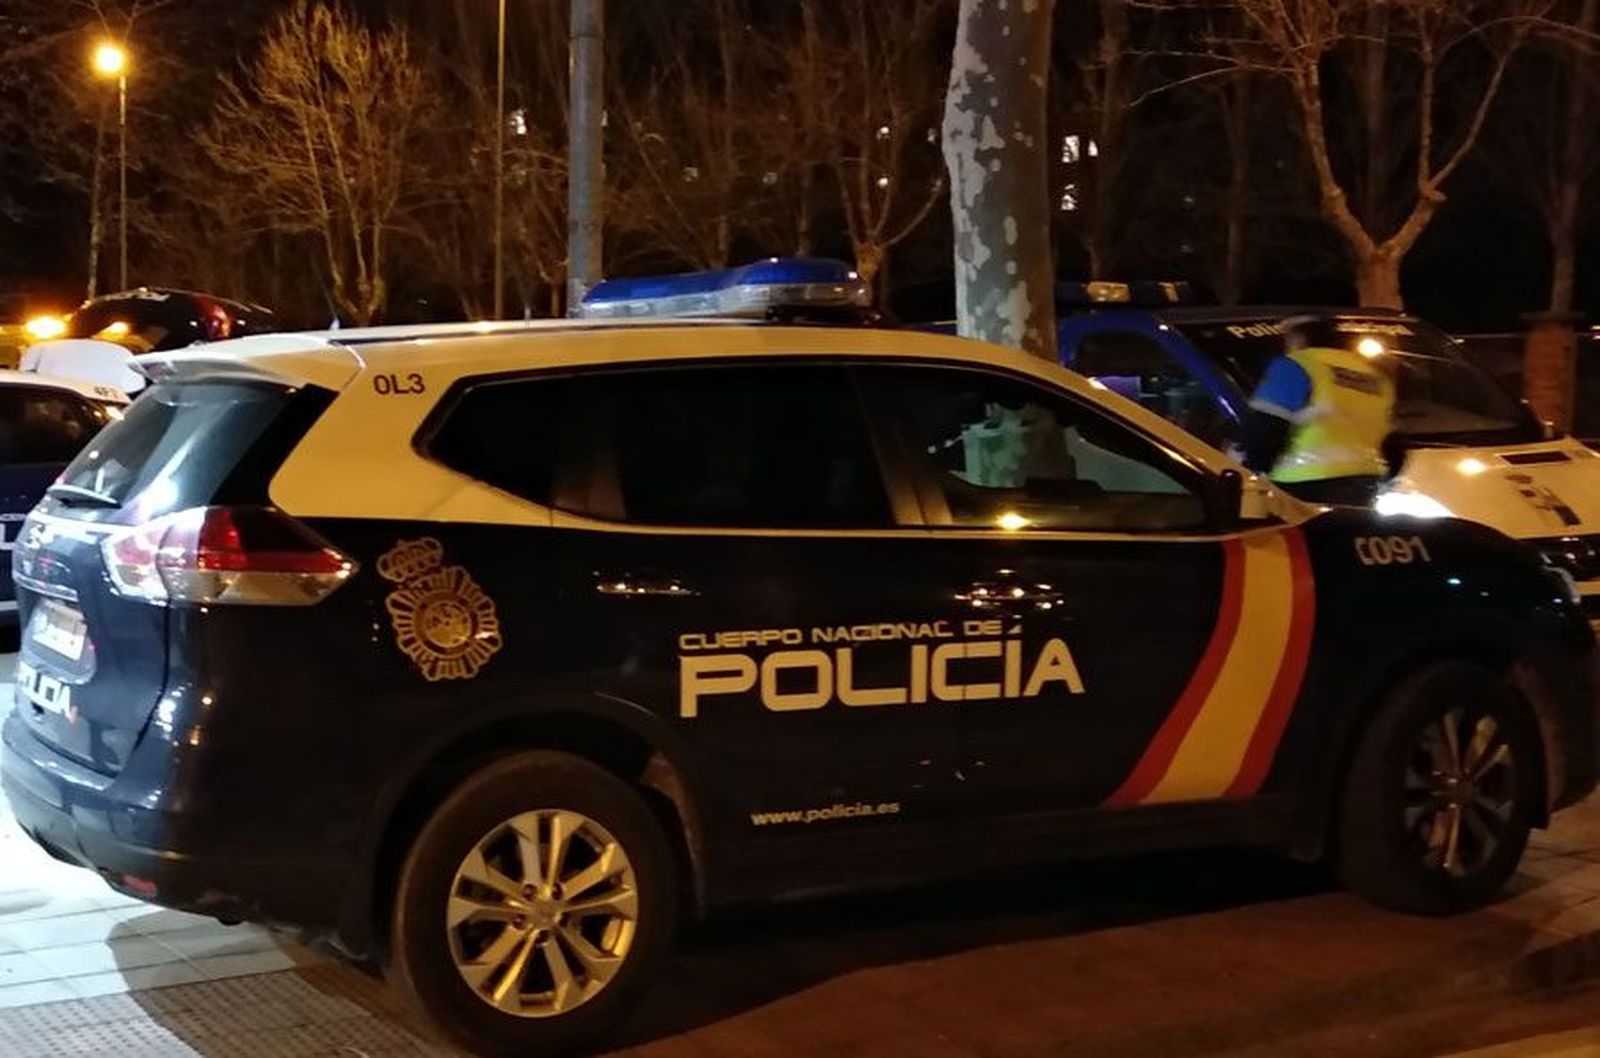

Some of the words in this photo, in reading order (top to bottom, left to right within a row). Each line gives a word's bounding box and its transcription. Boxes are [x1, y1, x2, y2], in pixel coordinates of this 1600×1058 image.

[679, 629, 802, 649] CUERPO
[812, 621, 954, 643] NACIONAL
[964, 620, 1003, 636] DE
[751, 803, 900, 826] www.policia.es
